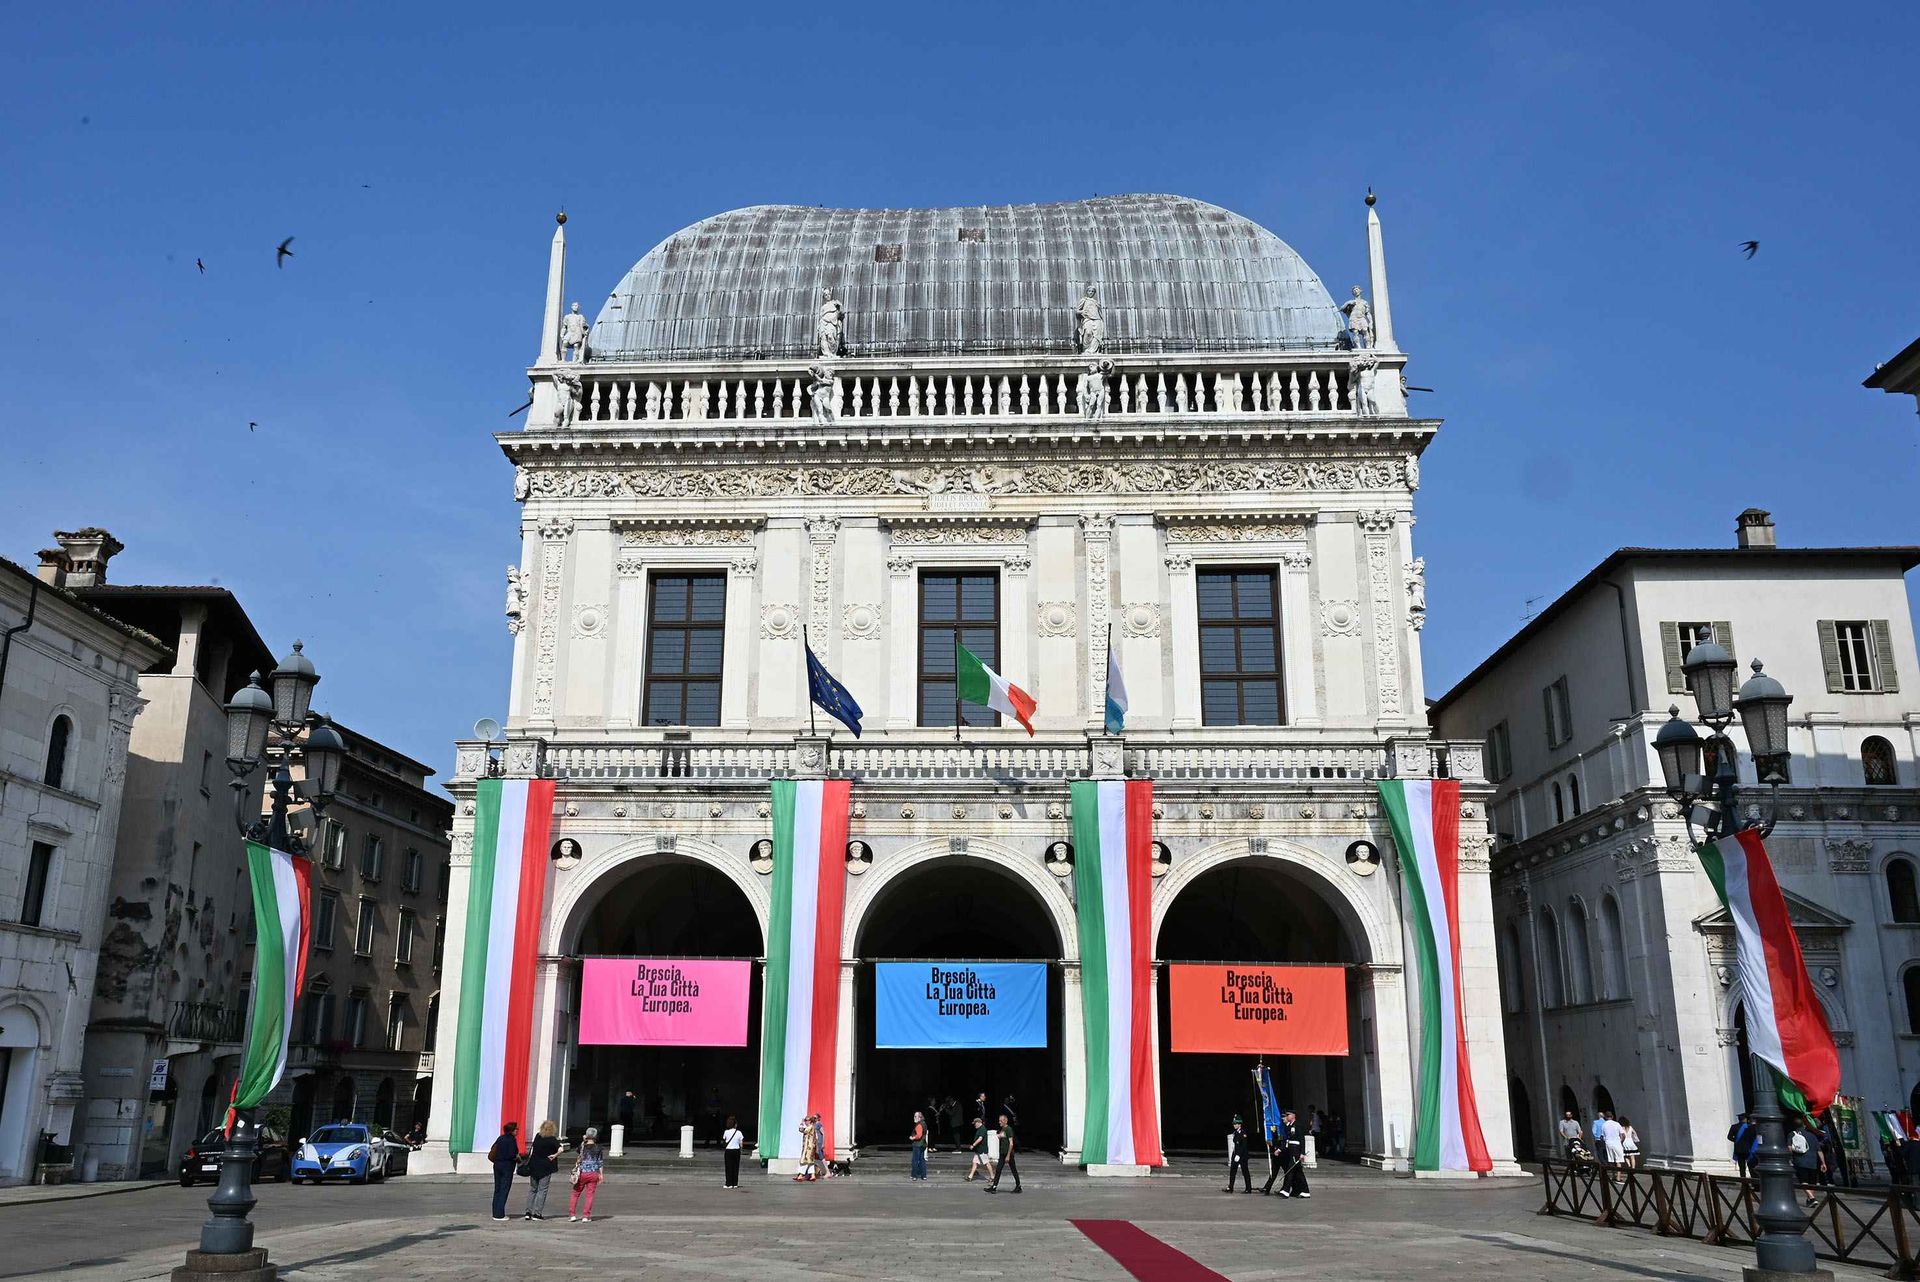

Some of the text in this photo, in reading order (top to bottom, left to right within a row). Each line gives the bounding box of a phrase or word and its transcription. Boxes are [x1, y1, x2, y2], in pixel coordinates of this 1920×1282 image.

[631, 979, 699, 997] La Tua Città
[926, 982, 996, 1000] La Tua Città
[1221, 986, 1293, 1004] La Tua Città
